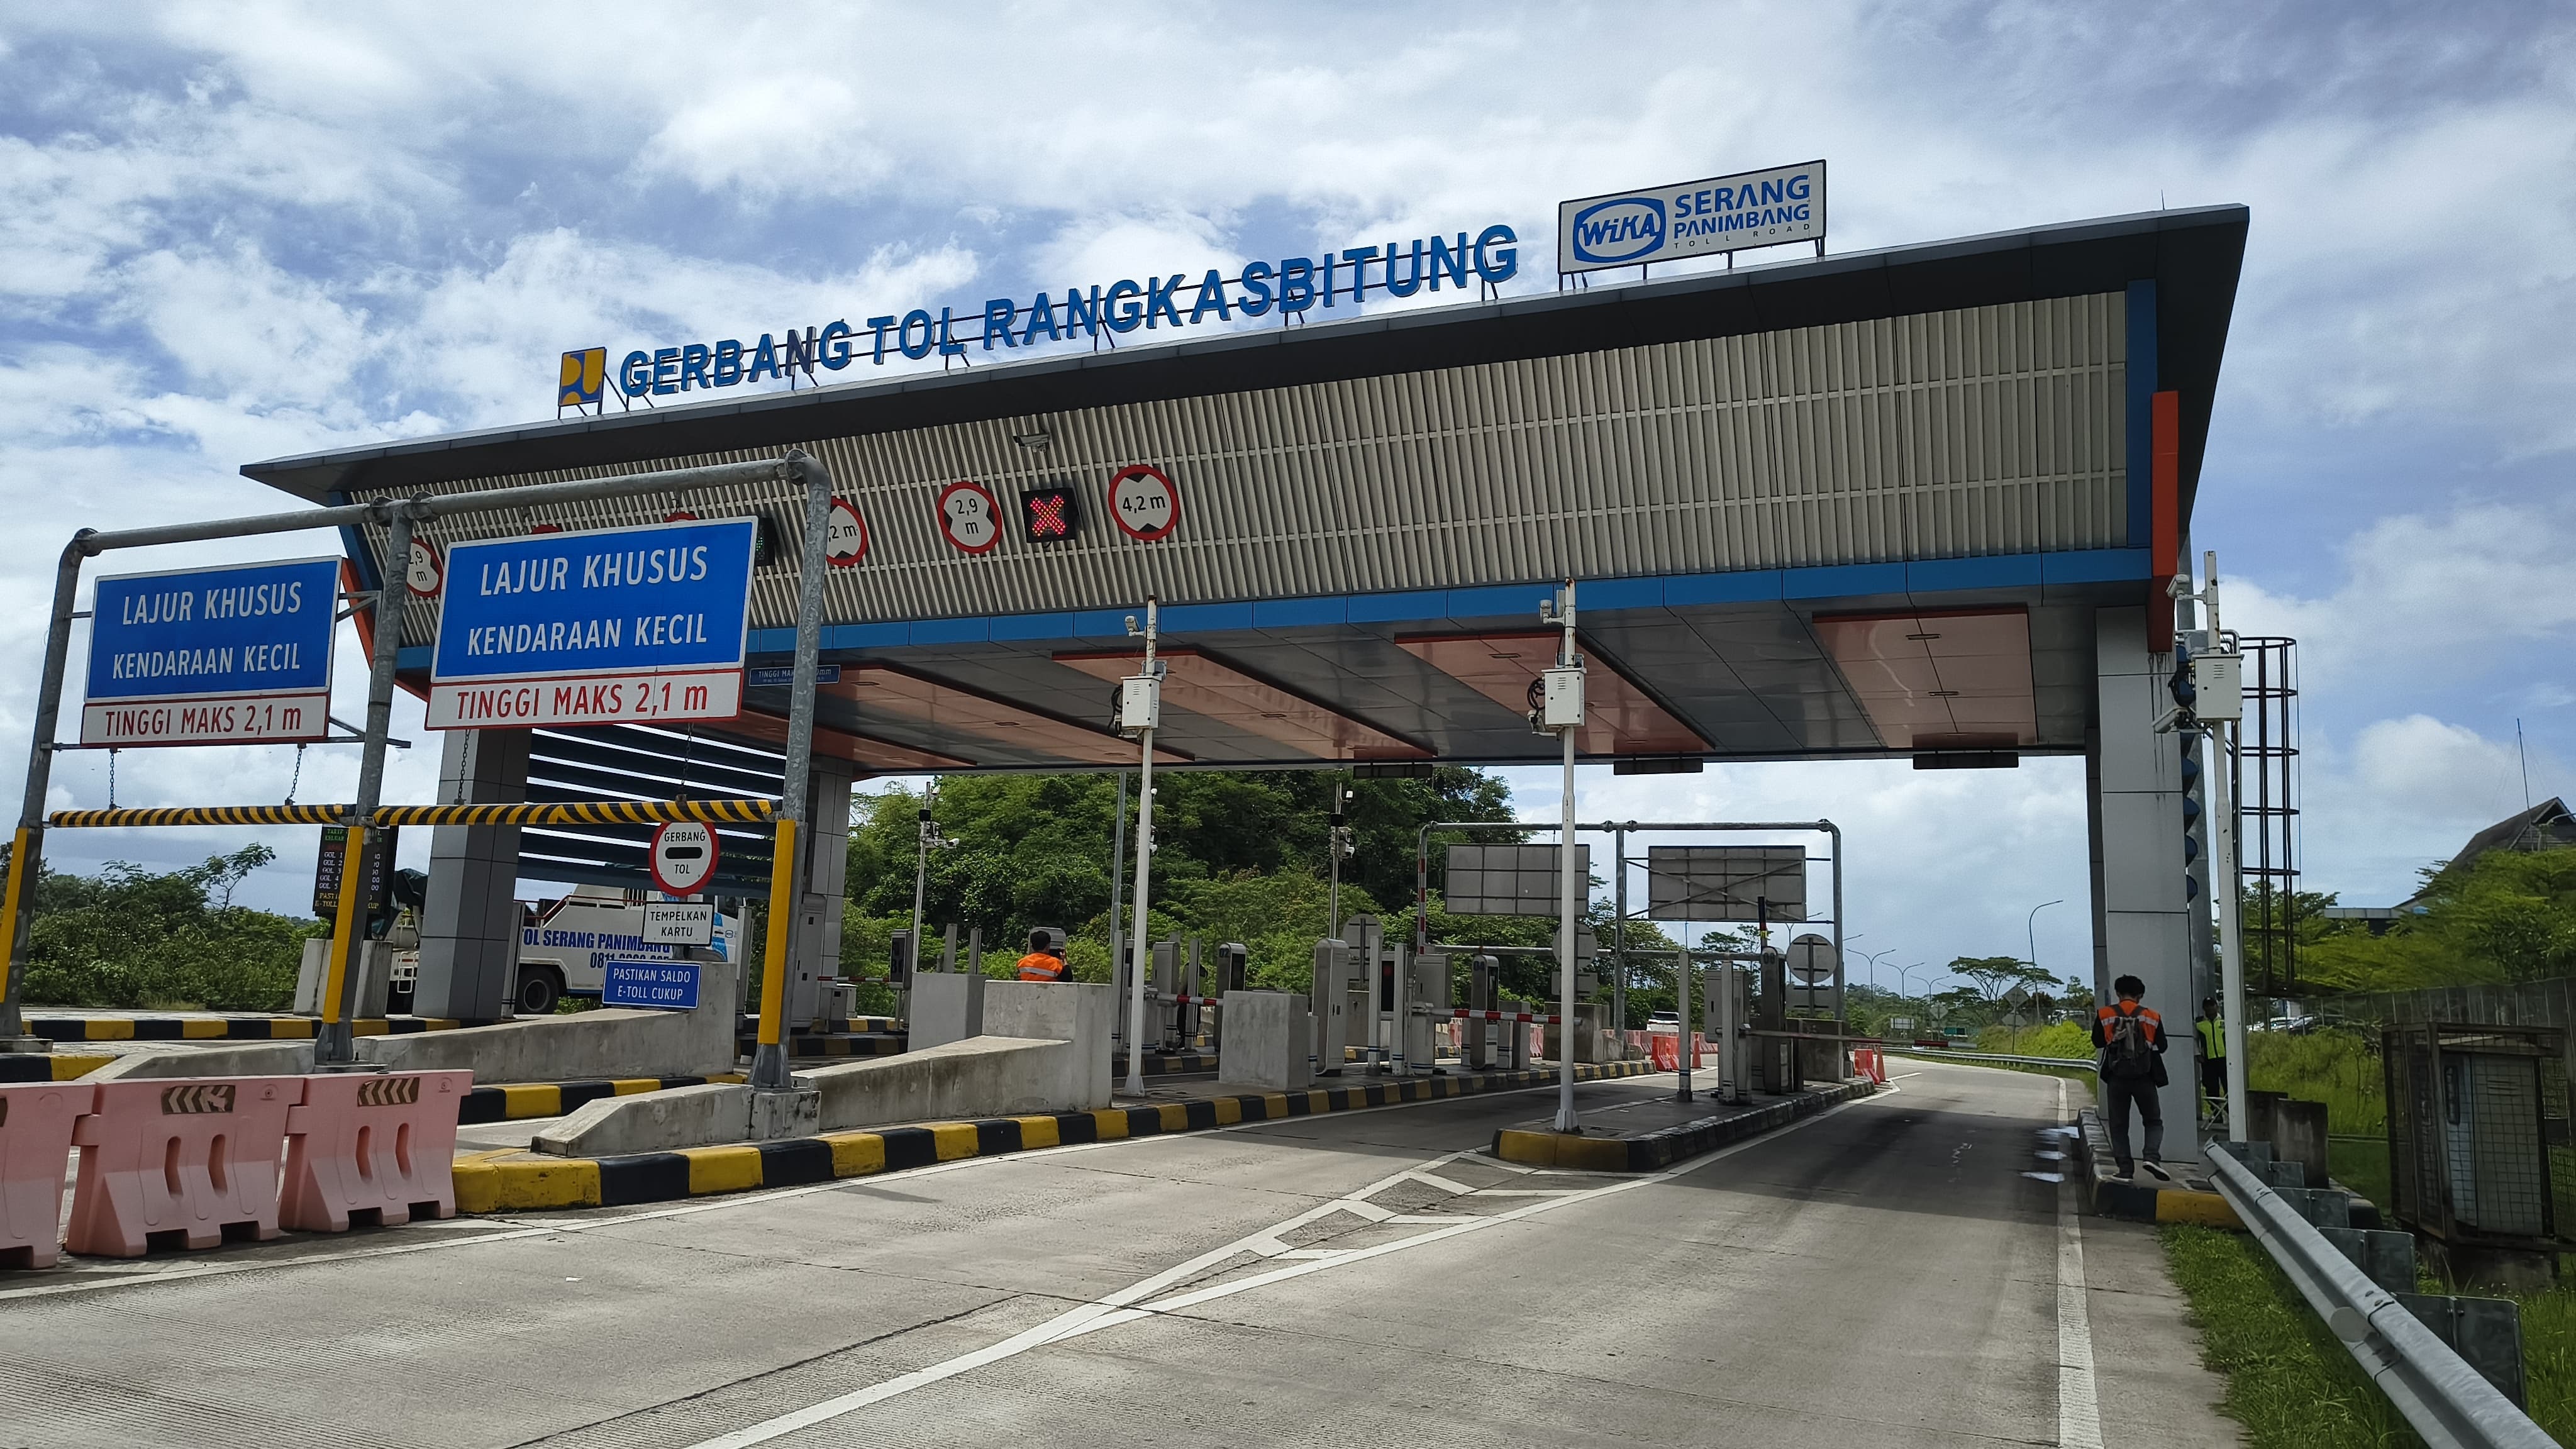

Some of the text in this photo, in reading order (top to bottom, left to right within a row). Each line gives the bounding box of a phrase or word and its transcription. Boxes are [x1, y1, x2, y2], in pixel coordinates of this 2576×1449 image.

[1675, 175, 1810, 219] SERANG
[1674, 204, 1810, 239] PANIMBANG
[1674, 223, 1809, 249] TOLL ROAD
[620, 225, 1518, 397] GERBANG TOL RANGKASBITUNG
[956, 498, 977, 516] 2,9
[1123, 496, 1165, 513] 4,2 m
[828, 525, 857, 542] ,2 m
[965, 522, 979, 534] m
[416, 570, 427, 582] m
[480, 545, 707, 596] LAJUR KHUSUS
[123, 582, 301, 625] LAJUR KHUSUS
[468, 614, 707, 655] KENDARAAN KECIL
[113, 643, 300, 679] KENDARAAN KECIL
[758, 670, 779, 678] TINGGI
[457, 682, 707, 719] TINGGI MAKS 2,1 m
[106, 704, 301, 736] TINGGI MAKS 2,1 m
[664, 831, 706, 842] GERBANG
[675, 864, 689, 874] TOL
[650, 911, 707, 921] TEMPELKAN
[523, 928, 539, 945] OL
[543, 930, 595, 948] SERANG
[661, 927, 692, 936] KARTU
[613, 968, 691, 983] PASTIKAN SALDO
[618, 985, 683, 1000] E-TOLL CUKUP
